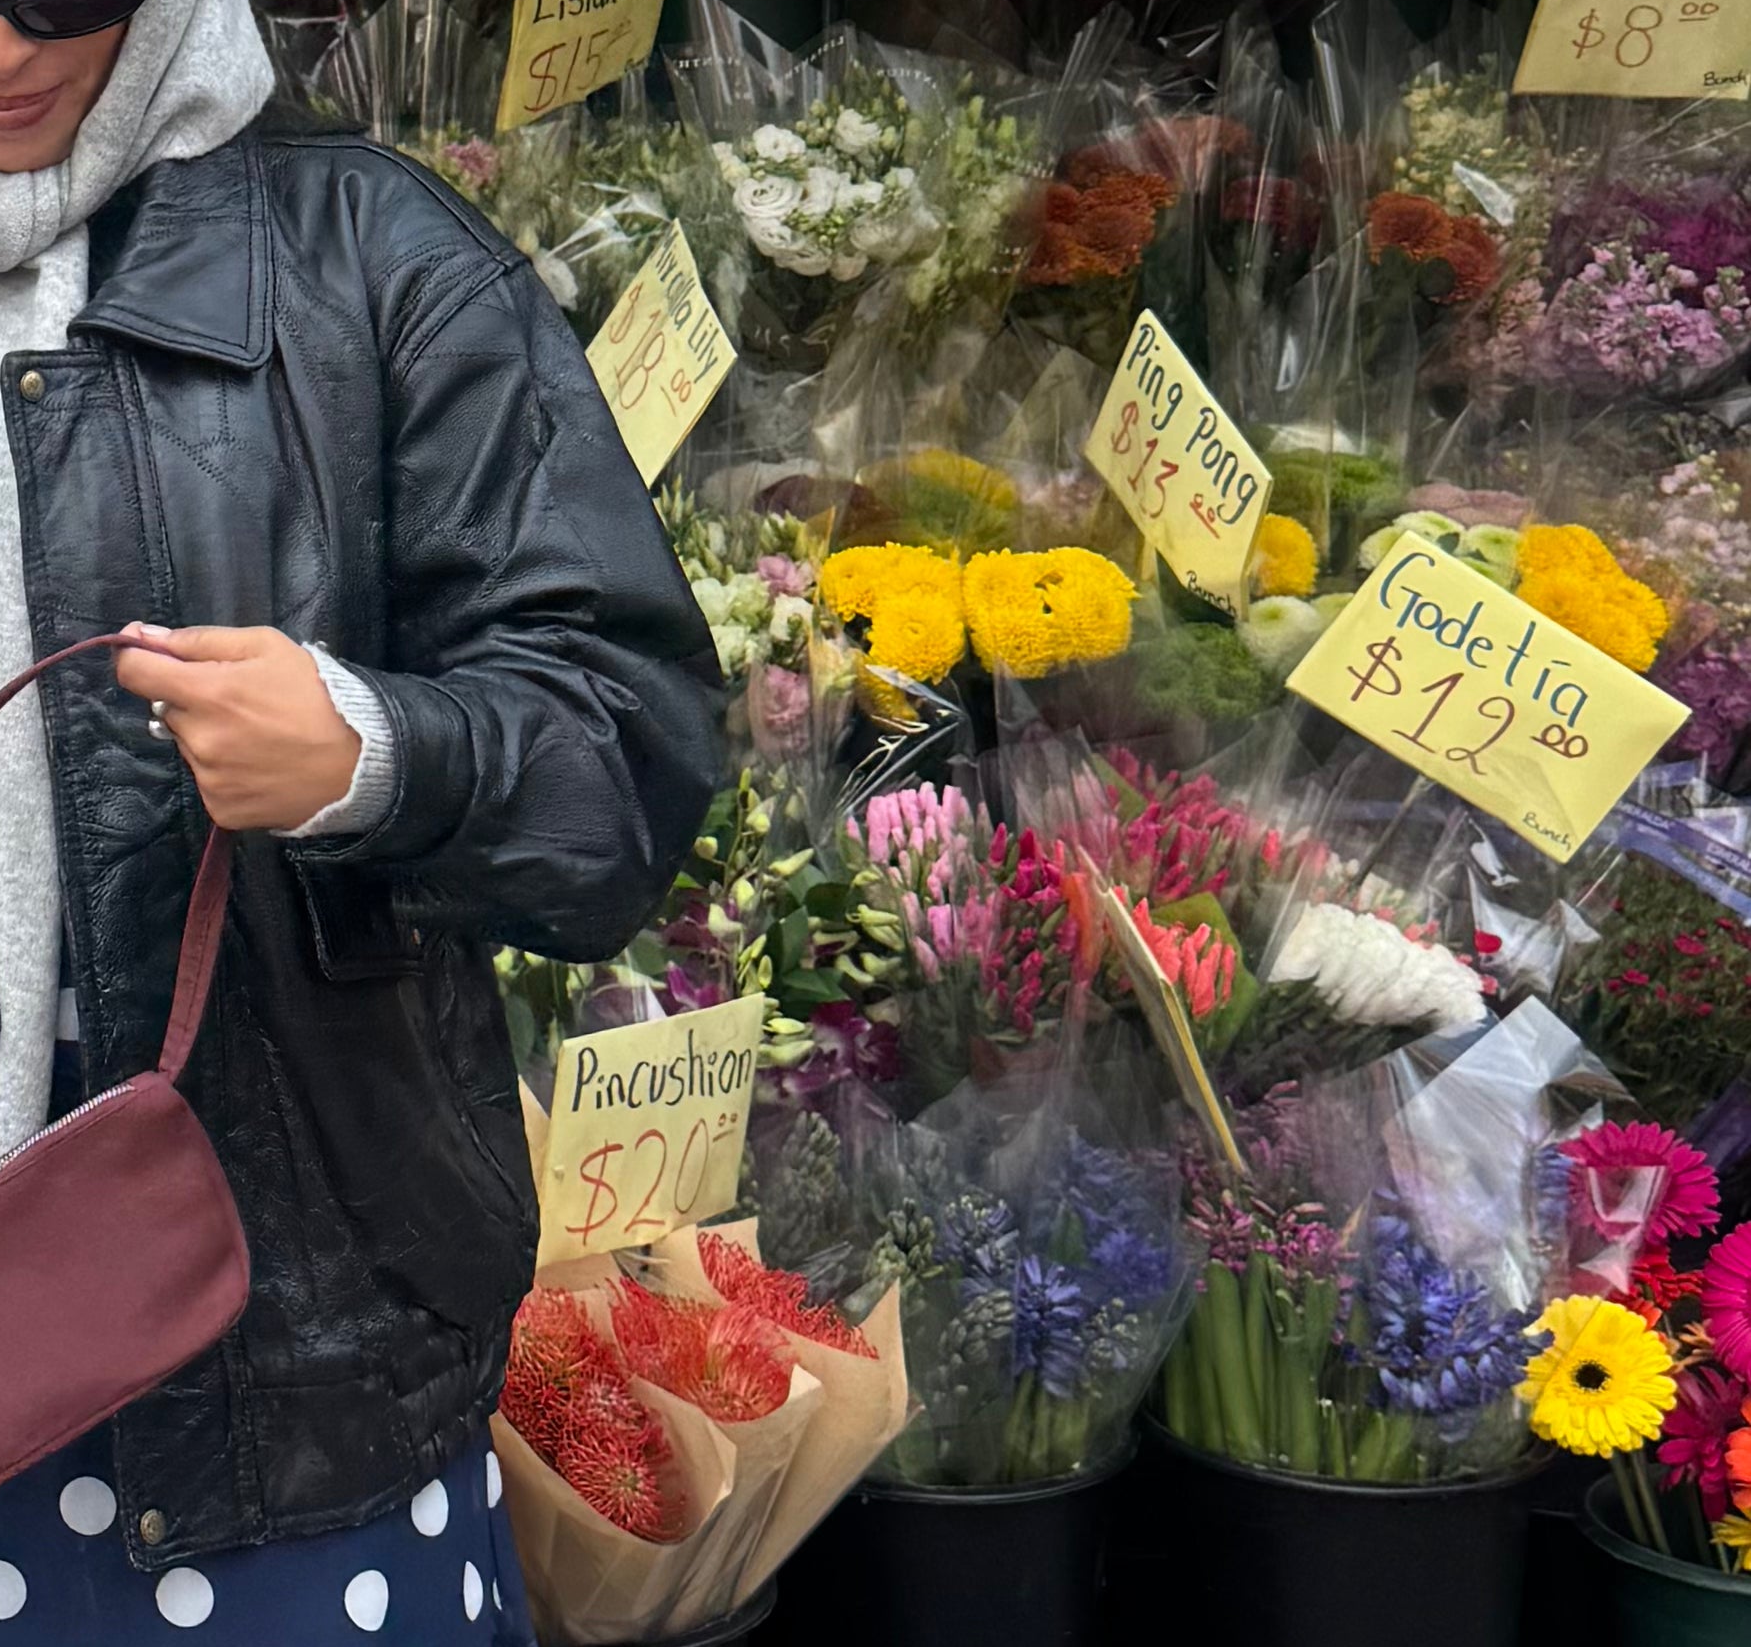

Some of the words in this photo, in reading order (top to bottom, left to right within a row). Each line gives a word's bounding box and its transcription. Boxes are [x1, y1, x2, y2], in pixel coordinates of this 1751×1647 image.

[1126, 323, 1183, 431] Ping
[1185, 406, 1258, 525] Pong
[1379, 551, 1589, 728] Godetia
[1522, 810, 1572, 852] Bunch
[571, 1029, 752, 1113] Pincushion
